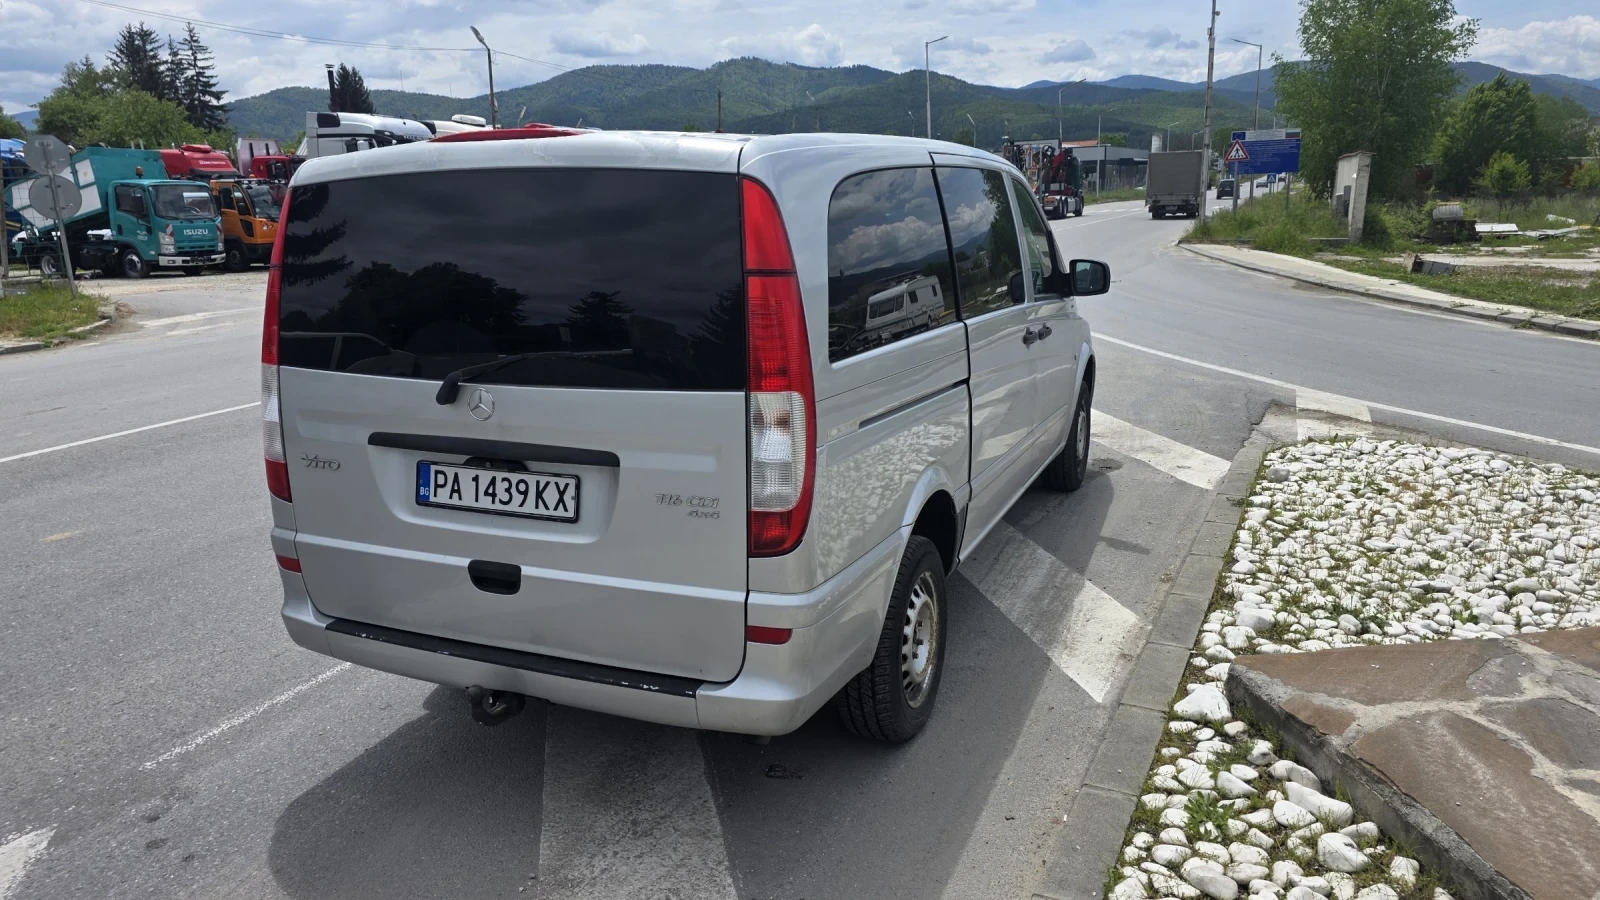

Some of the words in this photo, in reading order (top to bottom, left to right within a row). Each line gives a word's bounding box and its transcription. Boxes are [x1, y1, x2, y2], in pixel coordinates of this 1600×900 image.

[420, 487, 429, 496] BG
[433, 469, 463, 501] PA
[686, 495, 719, 508] CDI
